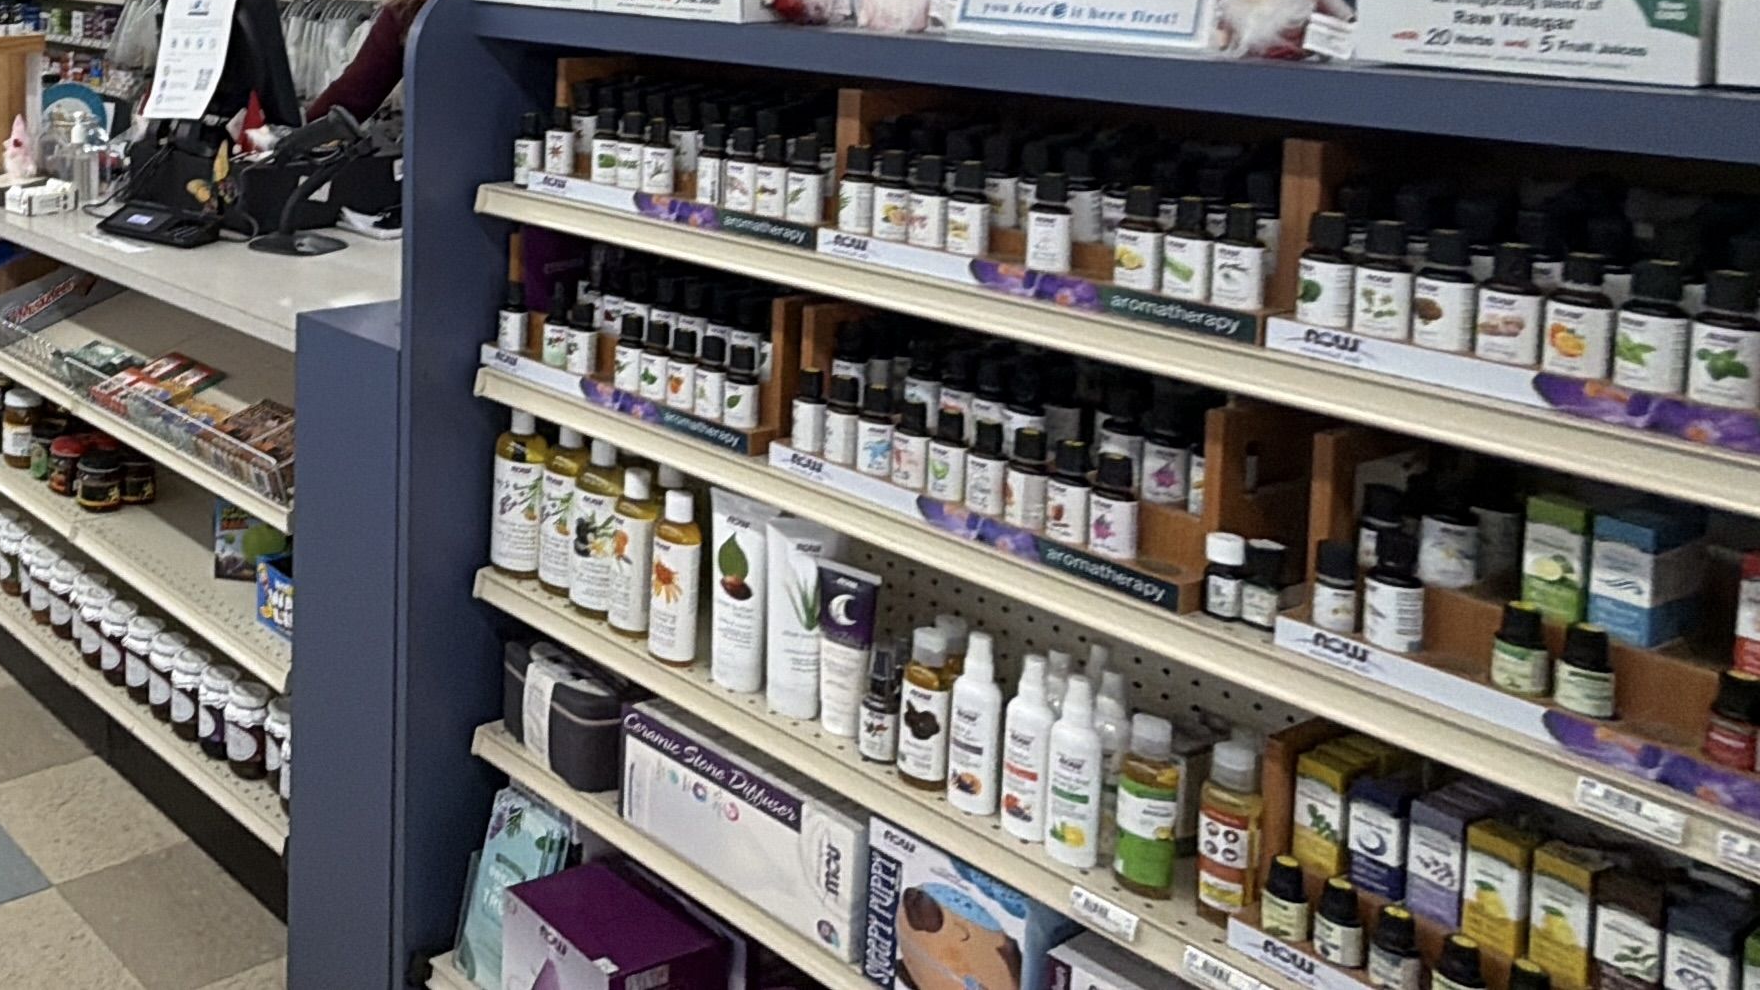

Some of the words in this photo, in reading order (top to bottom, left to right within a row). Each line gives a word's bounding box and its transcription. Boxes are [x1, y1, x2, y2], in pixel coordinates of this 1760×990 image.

[1453, 10, 1495, 25] Raw
[1498, 12, 1576, 30] Vinegar
[1110, 295, 1240, 335] aromatherapy
[1046, 546, 1168, 602] aromatherapy
[623, 712, 681, 756] Ceramic
[683, 745, 727, 781] Stone
[728, 769, 798, 822] Diffuser
[868, 851, 897, 920] PUPPY
